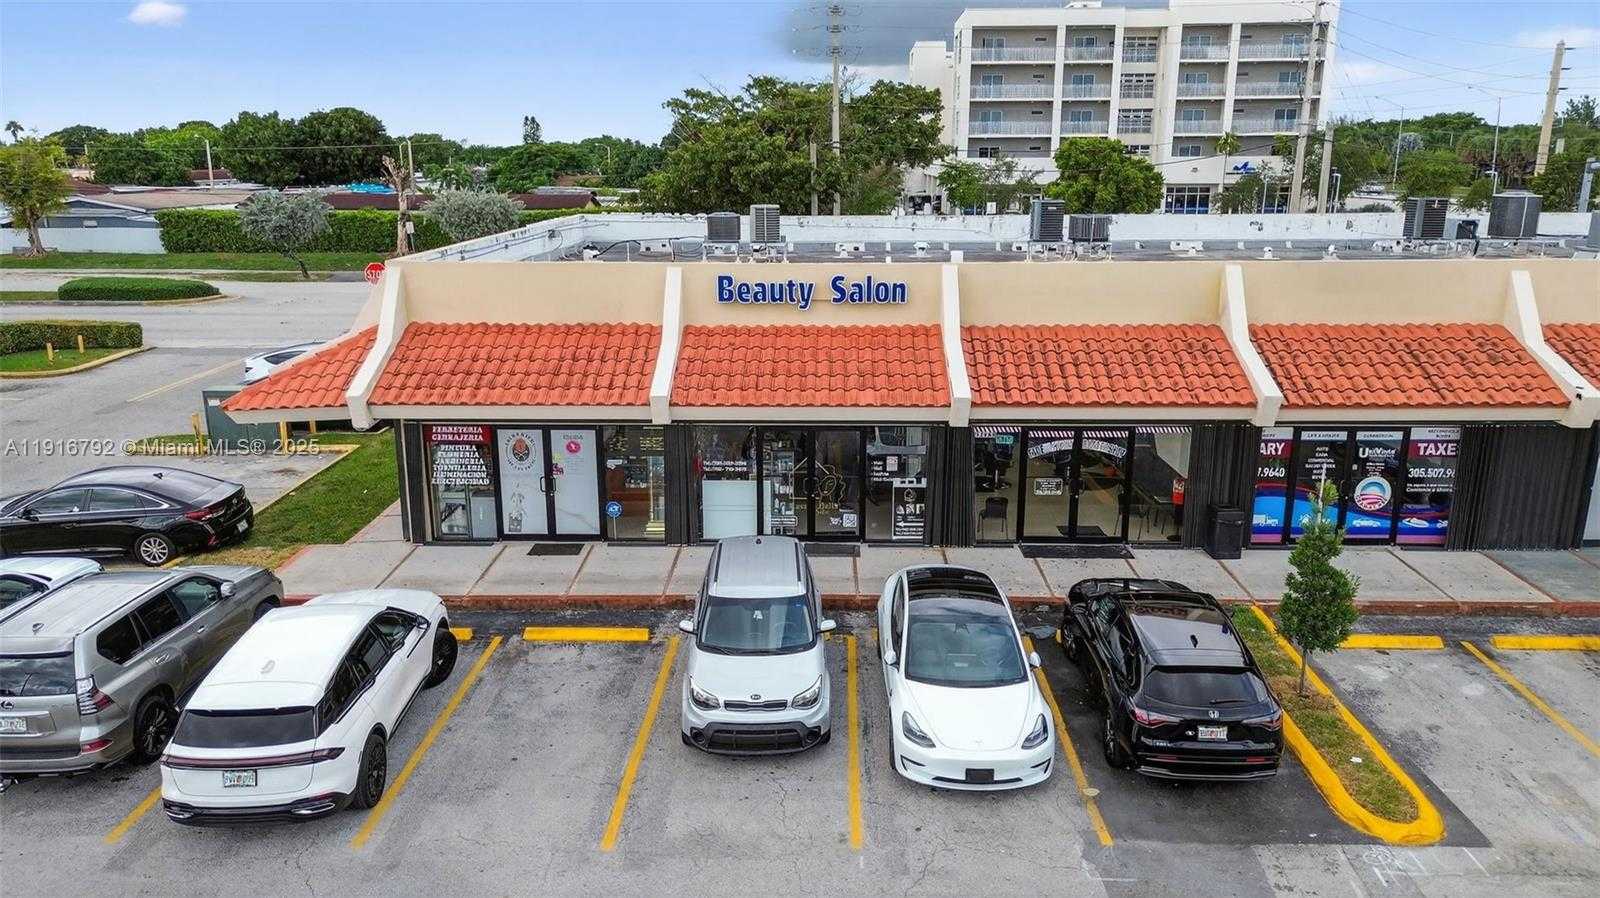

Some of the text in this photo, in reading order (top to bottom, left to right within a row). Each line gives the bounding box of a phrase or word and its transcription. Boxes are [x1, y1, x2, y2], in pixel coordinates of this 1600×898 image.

[717, 274, 908, 310] Beauty Salon
[432, 425, 483, 433] FERRETERIA
[432, 433, 484, 441] CERRAJERIA
